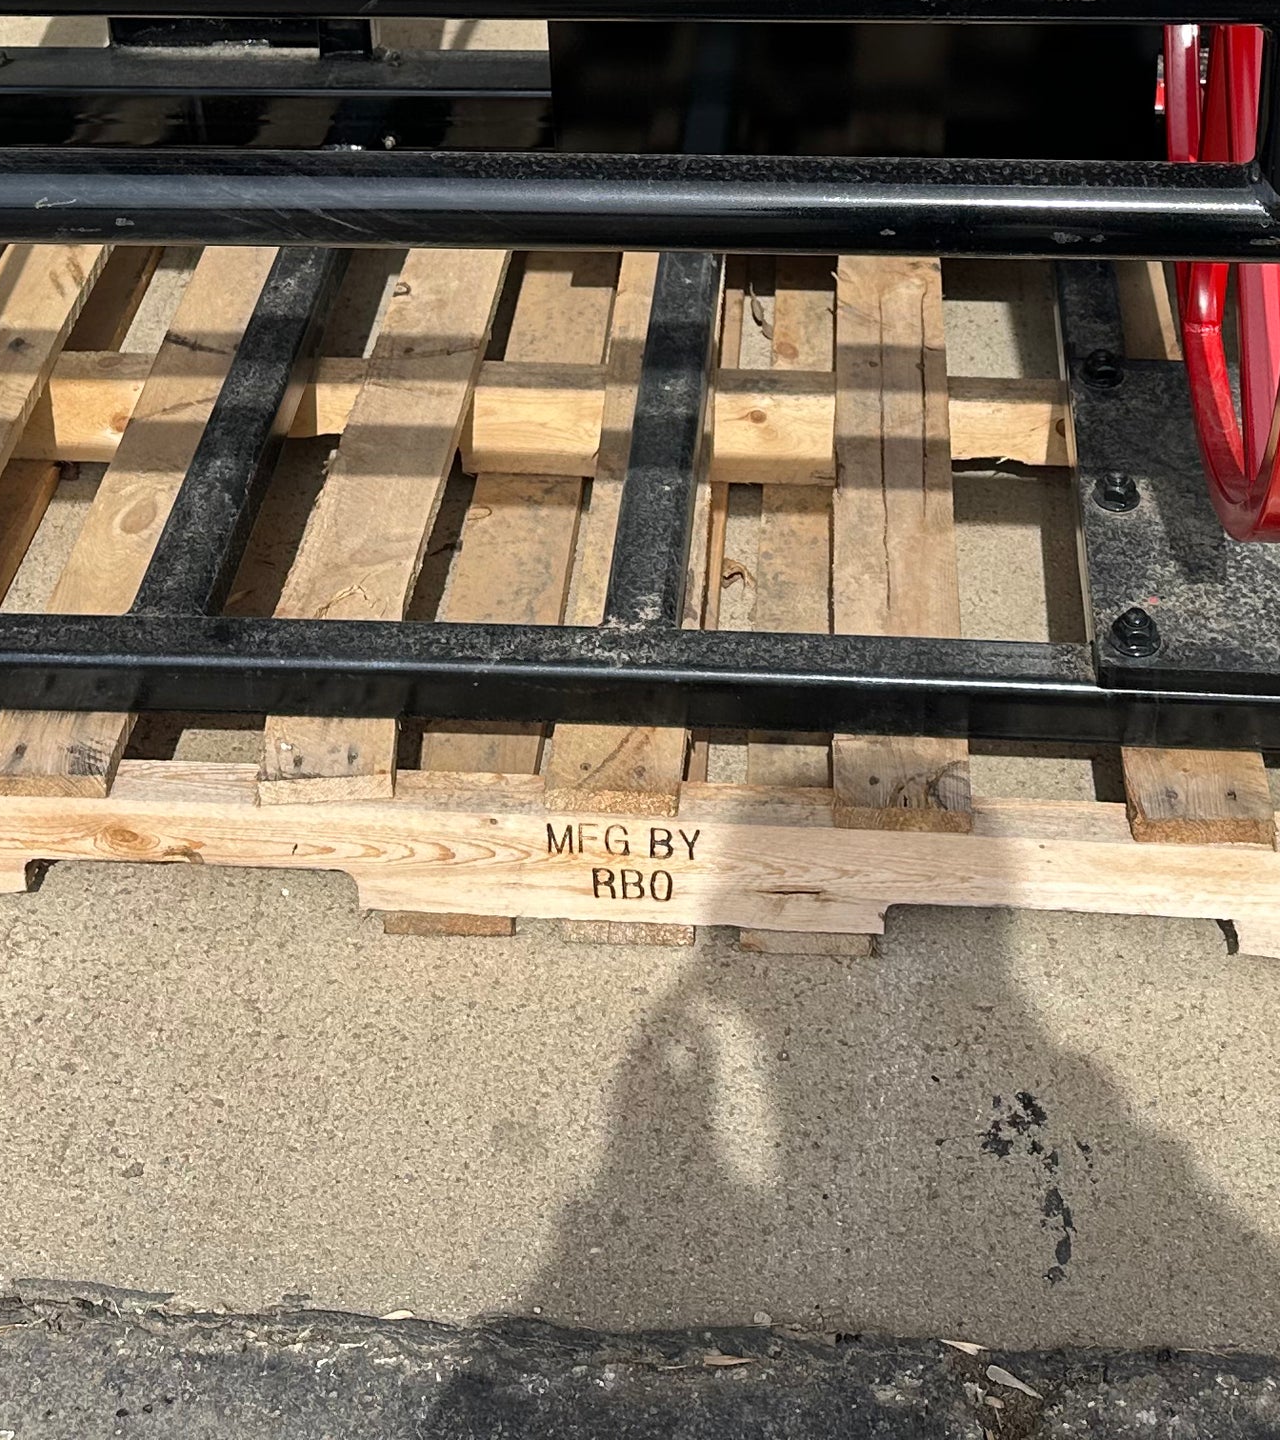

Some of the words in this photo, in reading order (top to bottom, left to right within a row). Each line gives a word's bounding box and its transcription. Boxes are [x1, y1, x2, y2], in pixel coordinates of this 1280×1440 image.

[546, 823, 631, 856] MFG
[649, 827, 701, 860] BY
[592, 868, 673, 902] RBO
